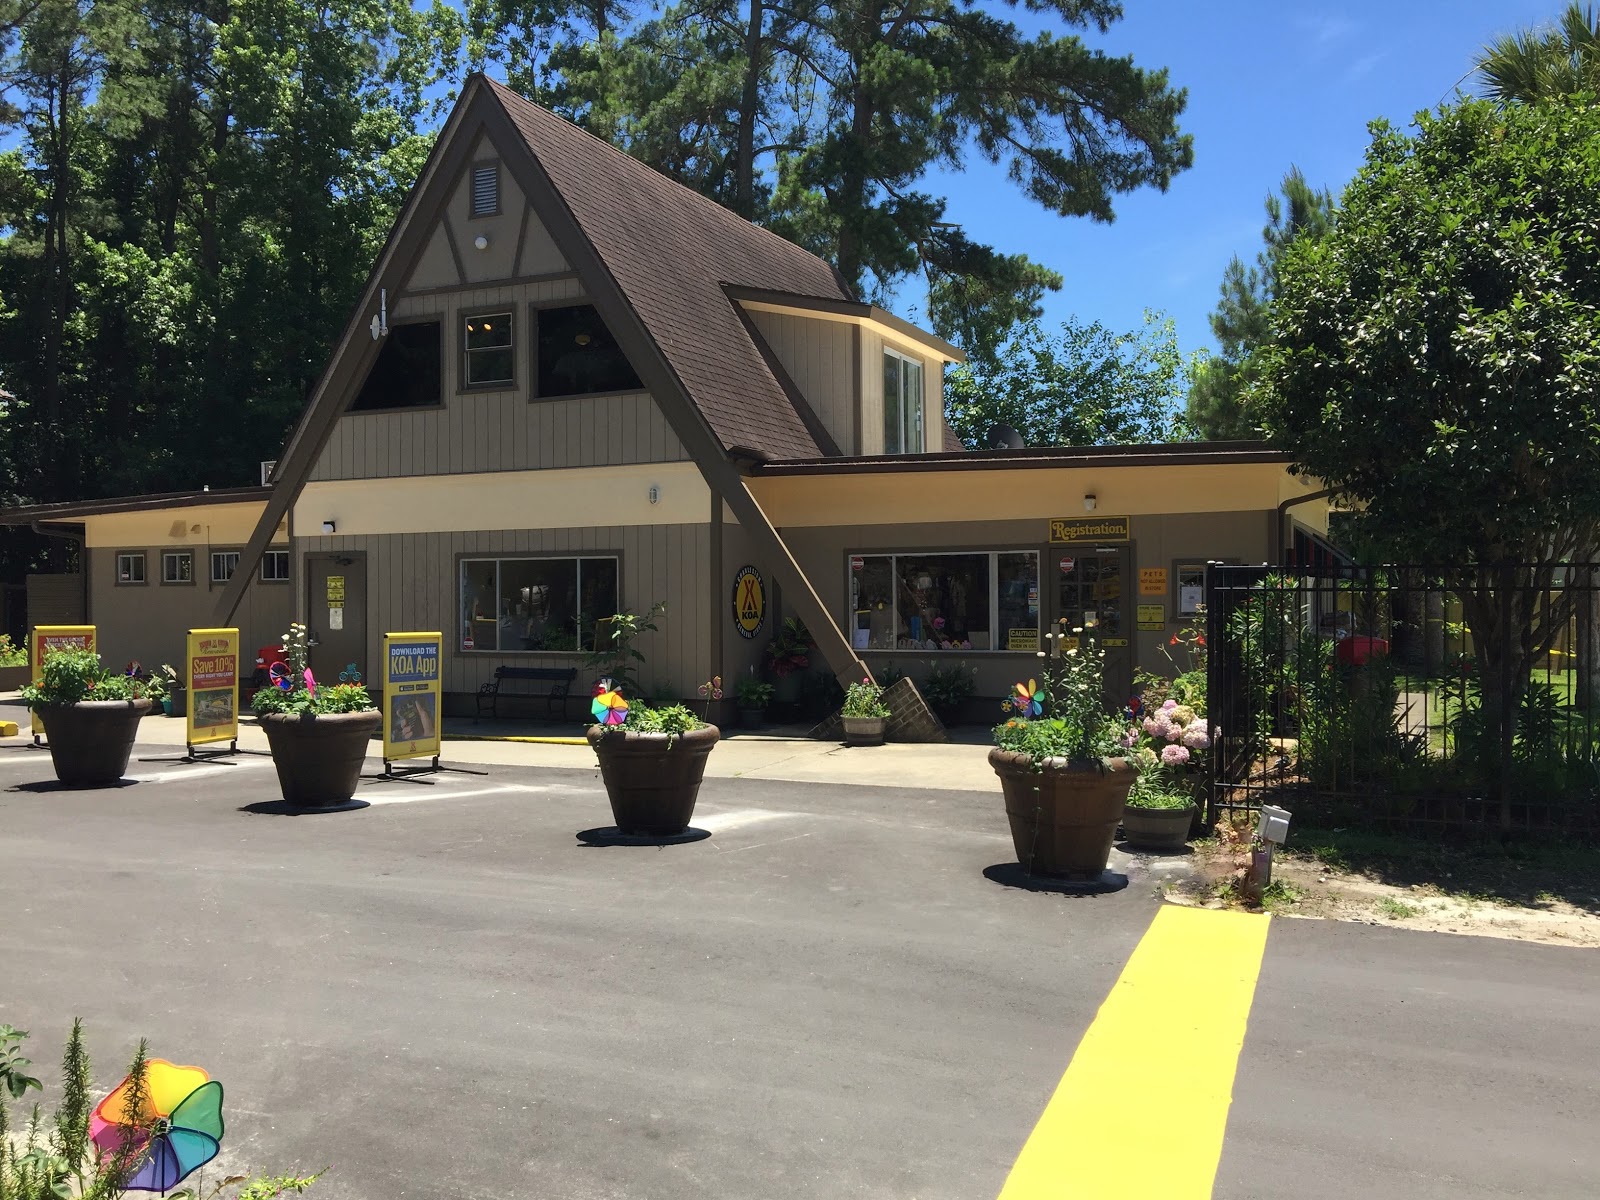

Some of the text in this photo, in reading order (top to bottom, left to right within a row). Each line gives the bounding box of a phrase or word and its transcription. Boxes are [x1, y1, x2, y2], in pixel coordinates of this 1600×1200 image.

[1052, 522, 1126, 540] Registration
[742, 612, 758, 620] KOA
[391, 646, 436, 656] DOWNLOAD THE
[194, 657, 234, 674] Save 10%
[392, 655, 437, 677] KOA App
